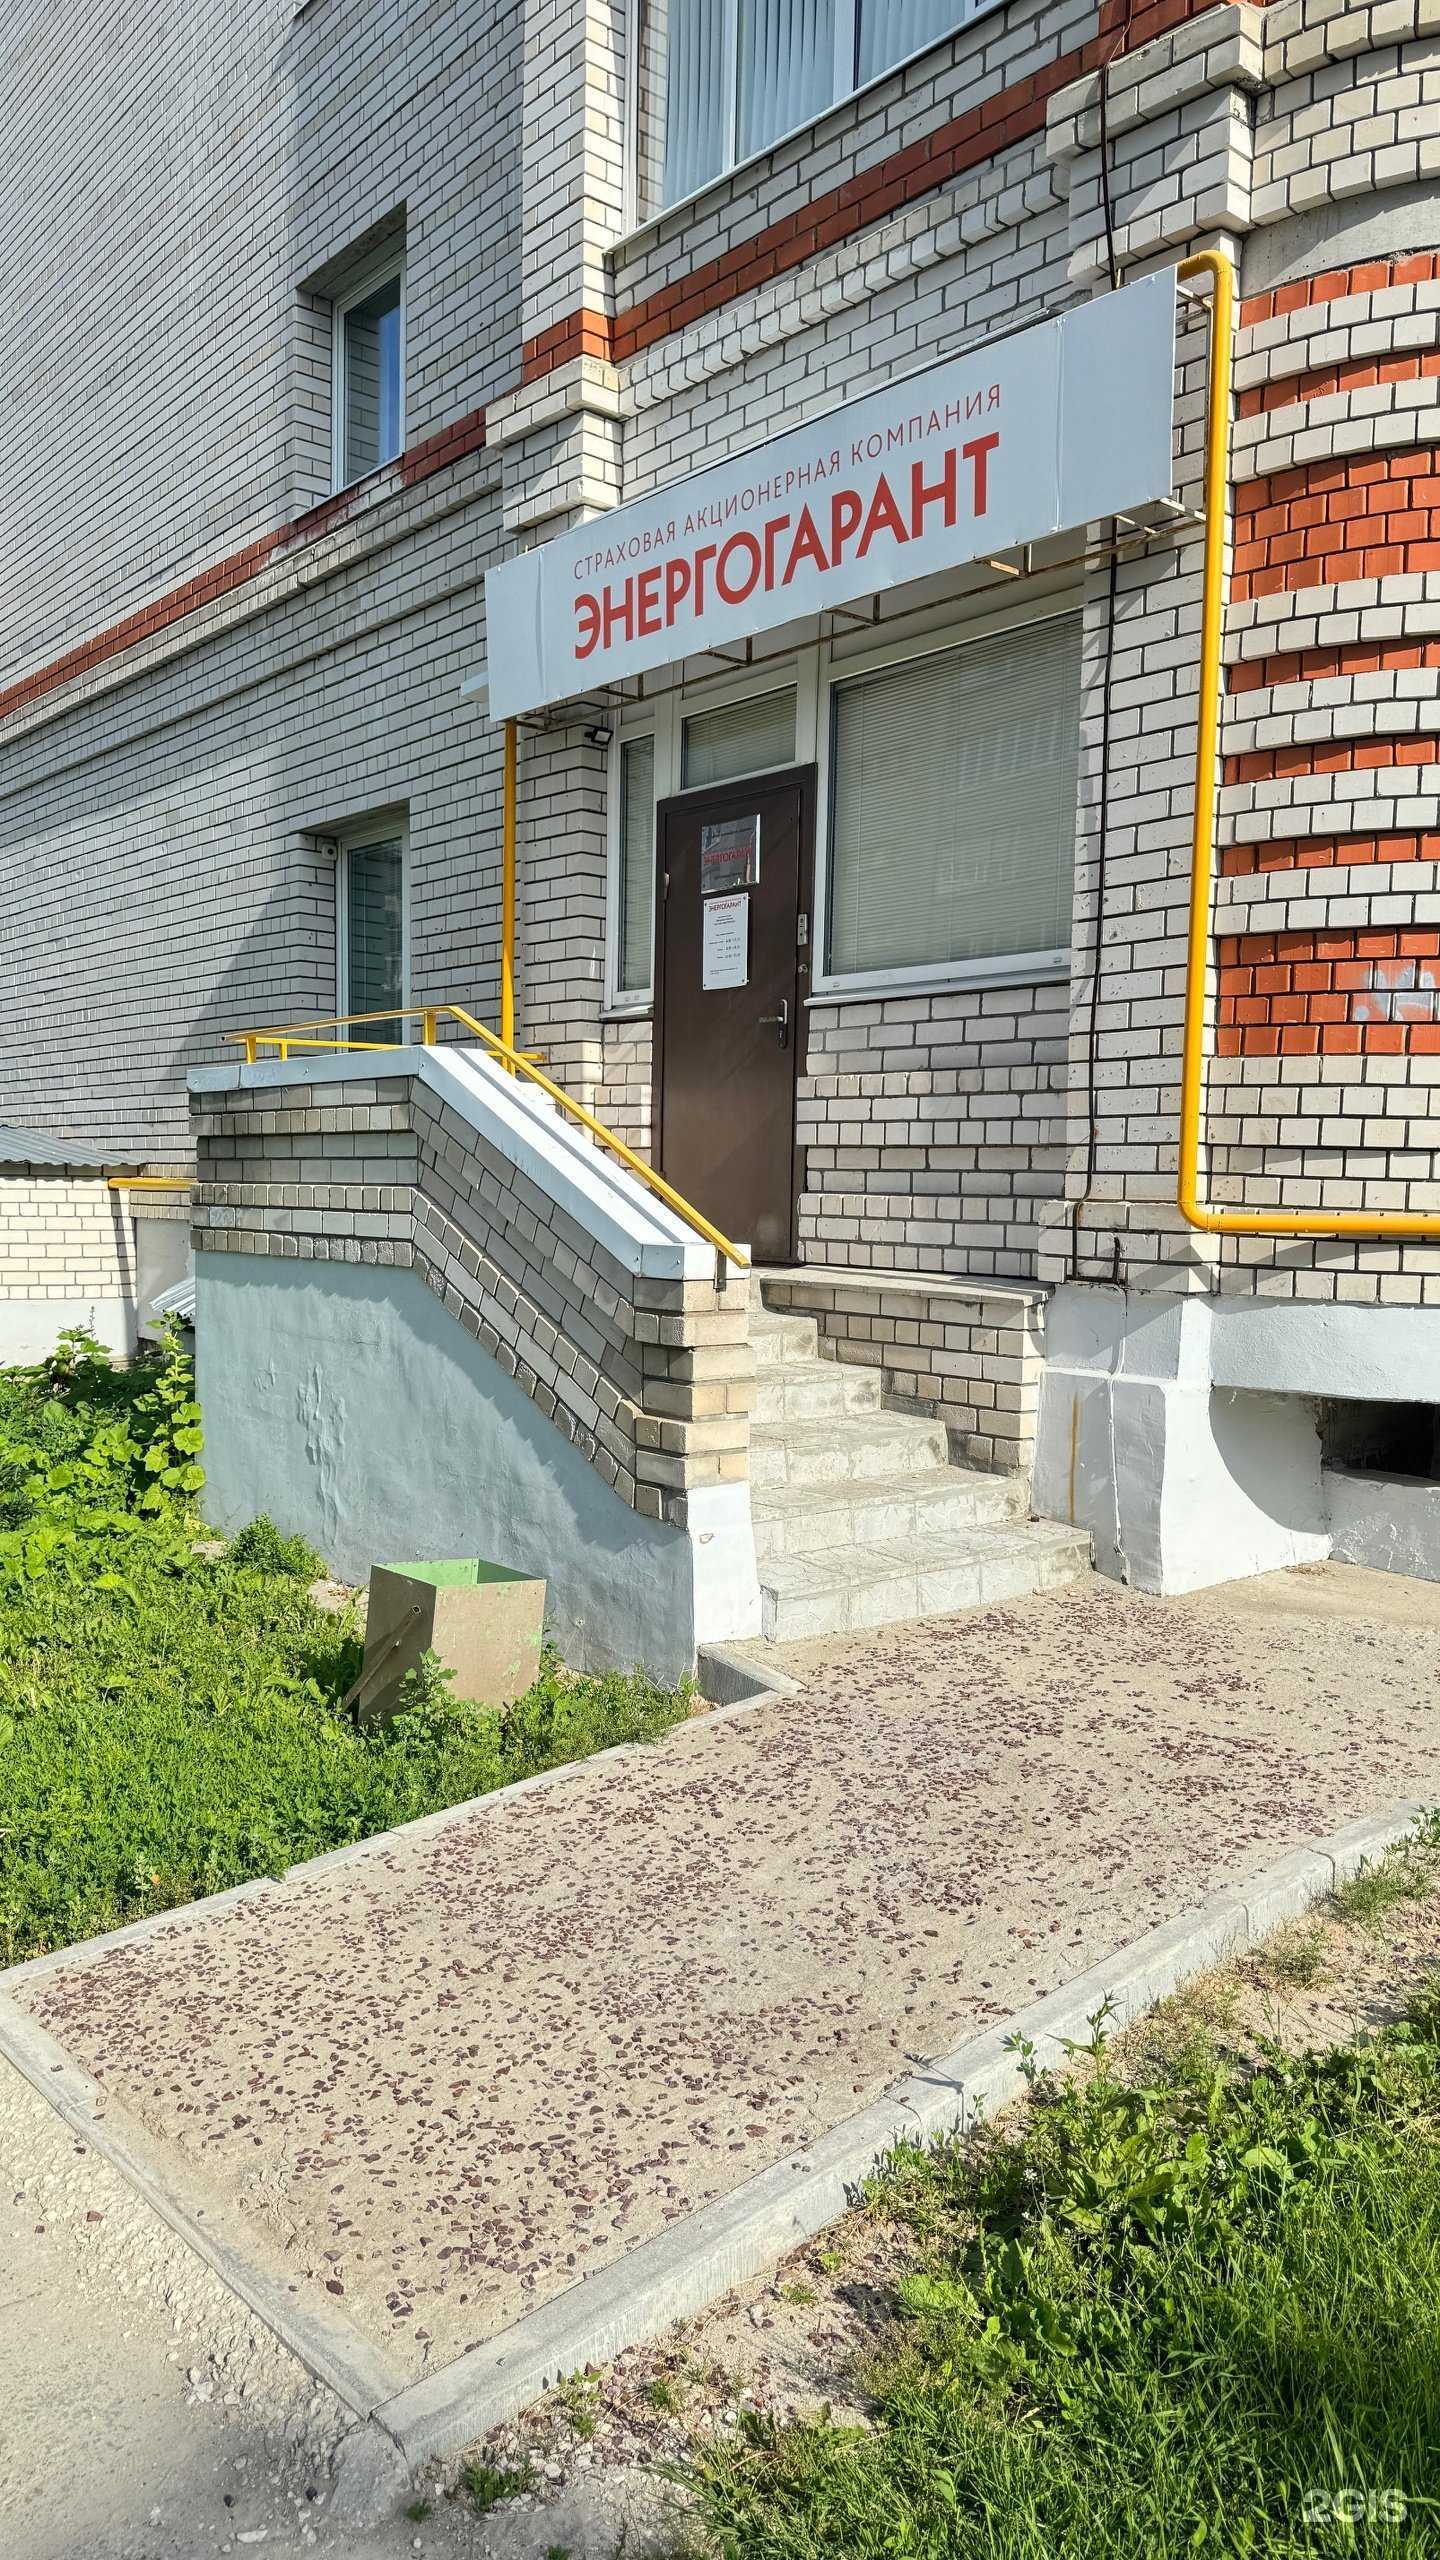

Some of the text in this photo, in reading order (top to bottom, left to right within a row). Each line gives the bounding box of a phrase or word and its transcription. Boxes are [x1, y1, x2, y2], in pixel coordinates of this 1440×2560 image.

[573, 383, 1001, 580] СТРАХОВАЯ АКЦИОНЕРНАЯ КОМПАНИЯ
[573, 431, 1001, 661] ЭНЕРГОГАРАНТ
